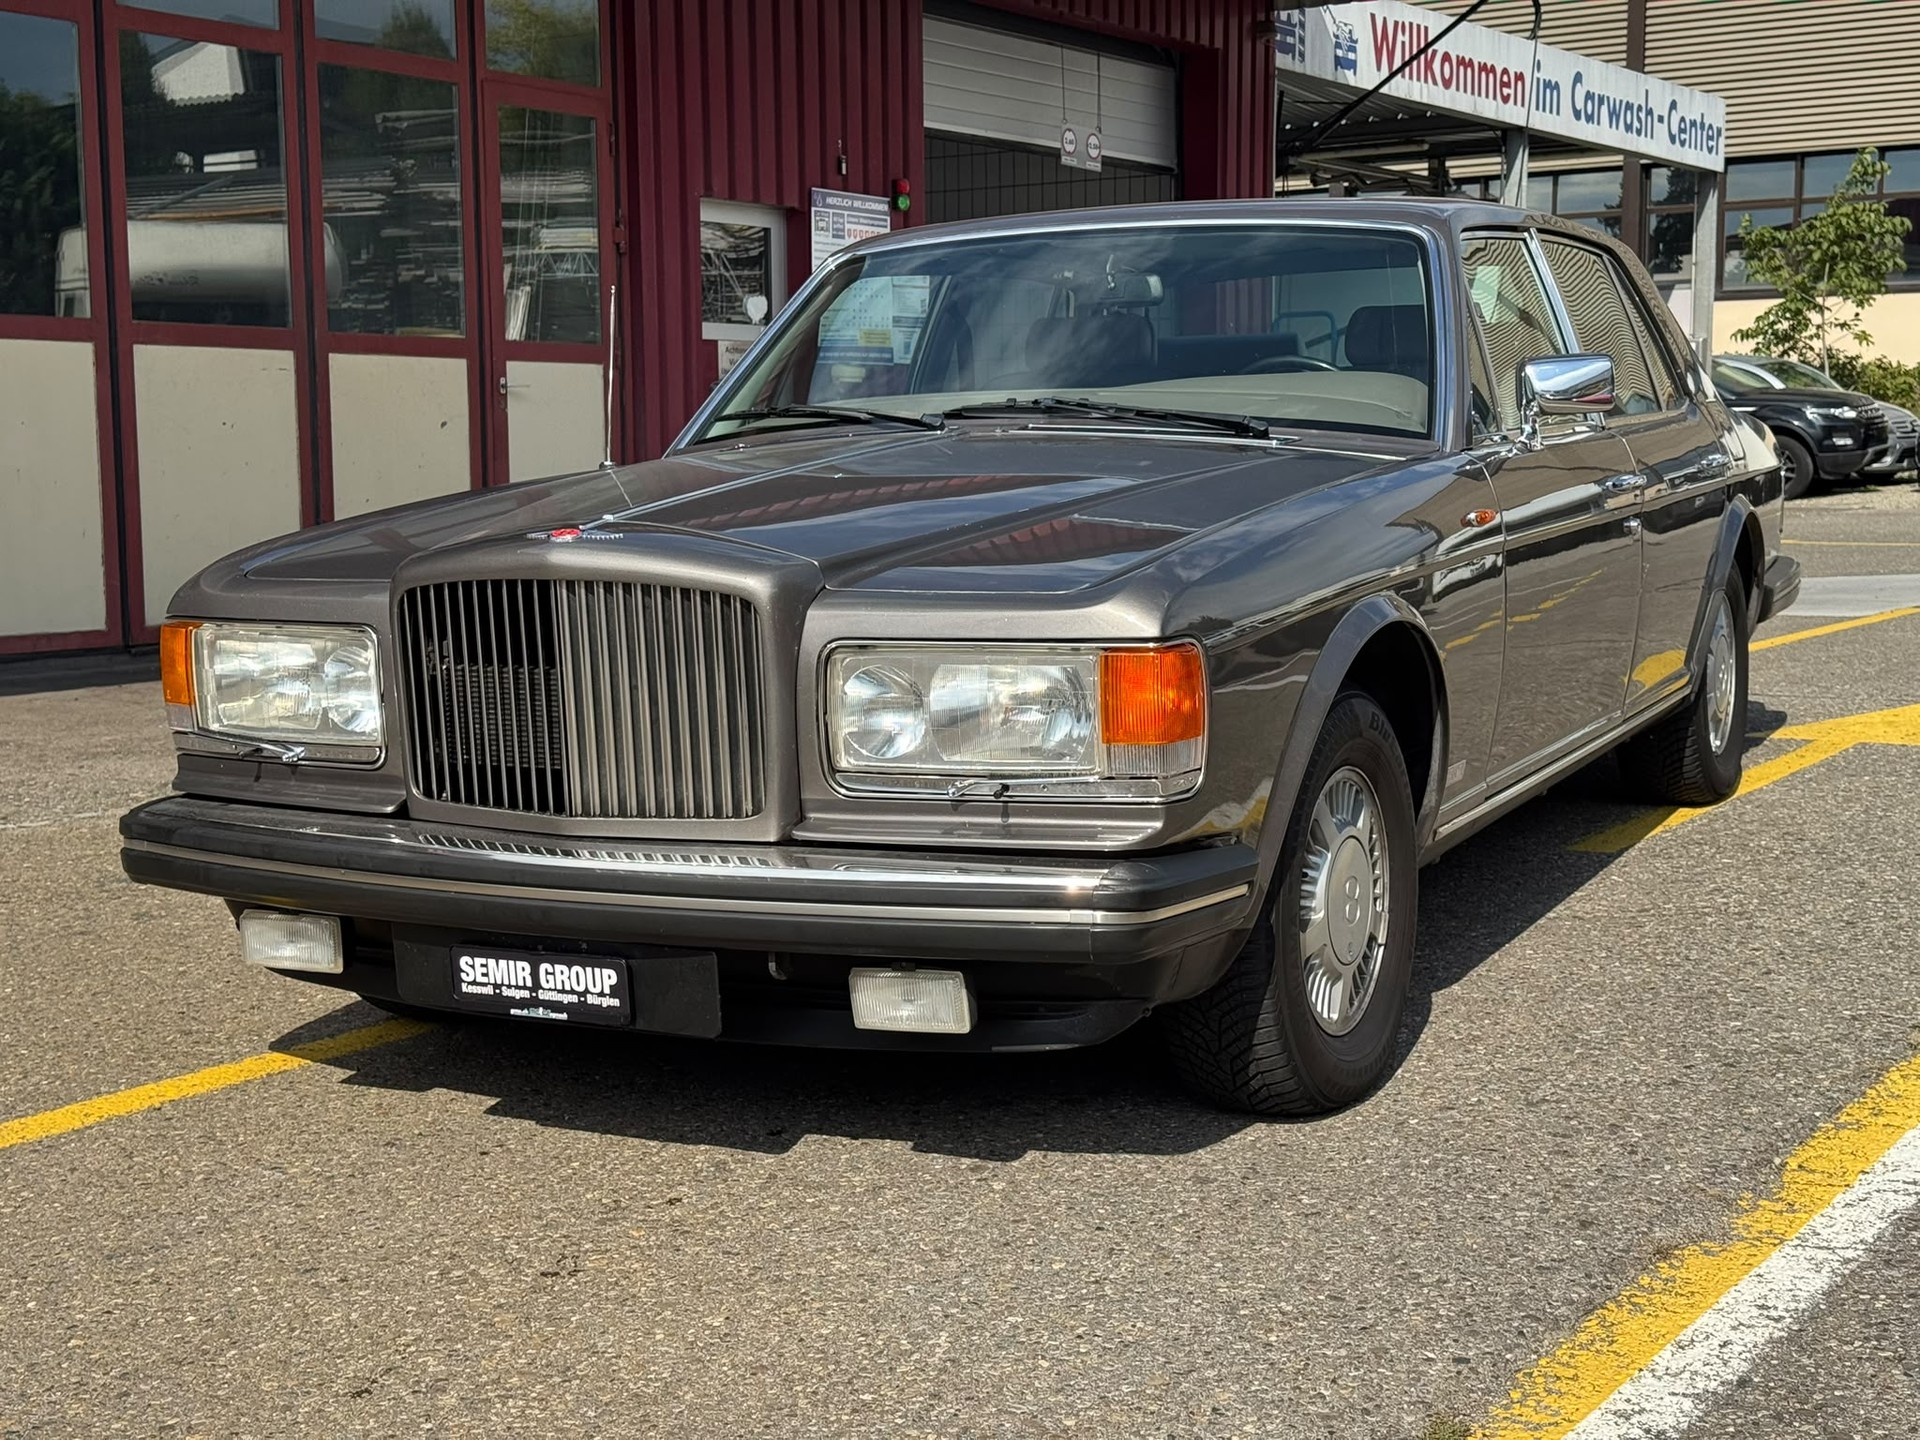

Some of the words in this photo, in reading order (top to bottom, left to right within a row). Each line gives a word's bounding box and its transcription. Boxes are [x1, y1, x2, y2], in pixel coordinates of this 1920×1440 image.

[1369, 13, 1526, 108] Willkommen
[1535, 59, 1561, 116] im
[1571, 71, 1722, 156] Carwash-Center
[826, 197, 852, 206] HERZLICH
[853, 201, 888, 211] WILLKOMMEN
[459, 956, 533, 987] SEMIR
[539, 963, 618, 994] GROUP
[461, 982, 494, 996] Kesswil
[501, 986, 530, 999] Sulgen
[538, 989, 578, 1004] Güttingen
[587, 994, 621, 1008] Bürglen
